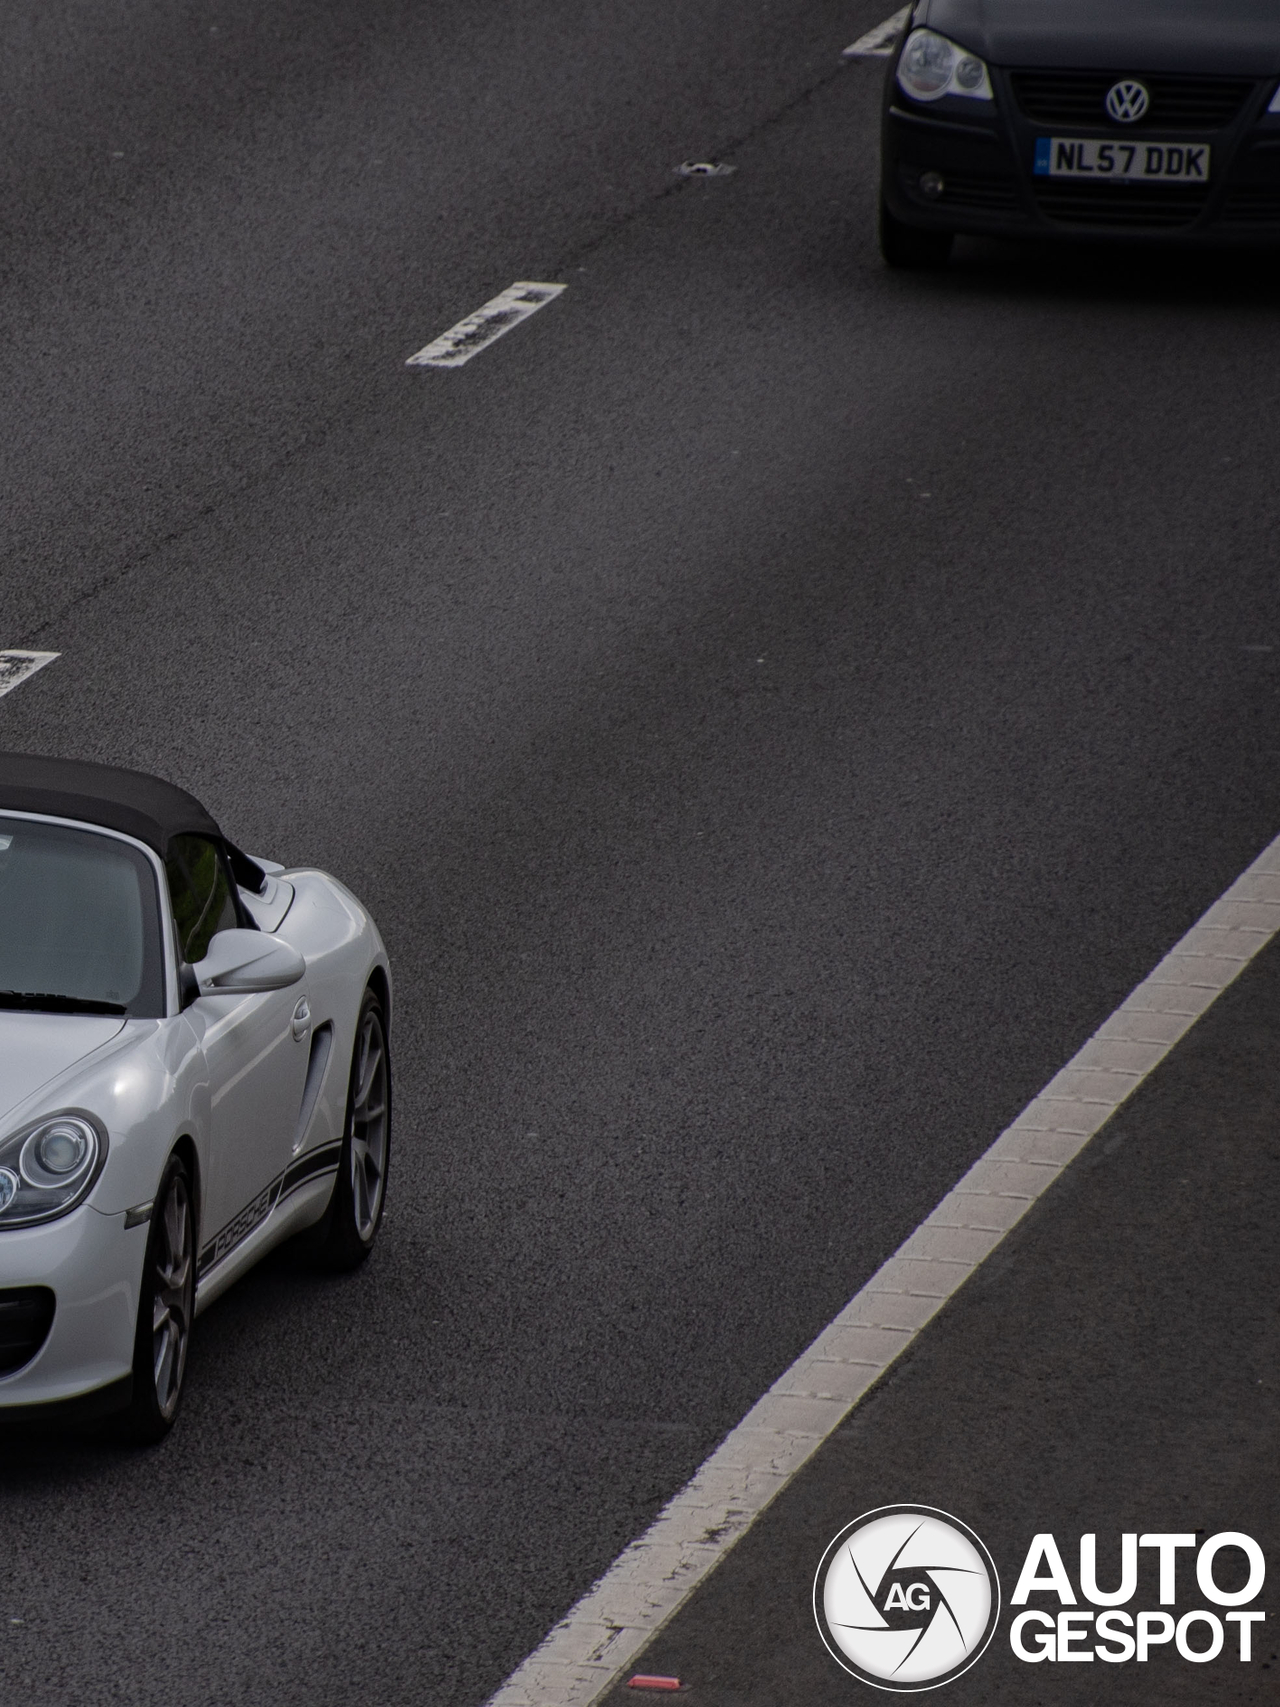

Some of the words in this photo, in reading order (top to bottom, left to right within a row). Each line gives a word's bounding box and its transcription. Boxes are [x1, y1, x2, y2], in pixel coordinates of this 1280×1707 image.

[1056, 142, 1136, 173] NL57
[1144, 146, 1206, 176] DDK
[217, 1191, 269, 1255] PORSCHE
